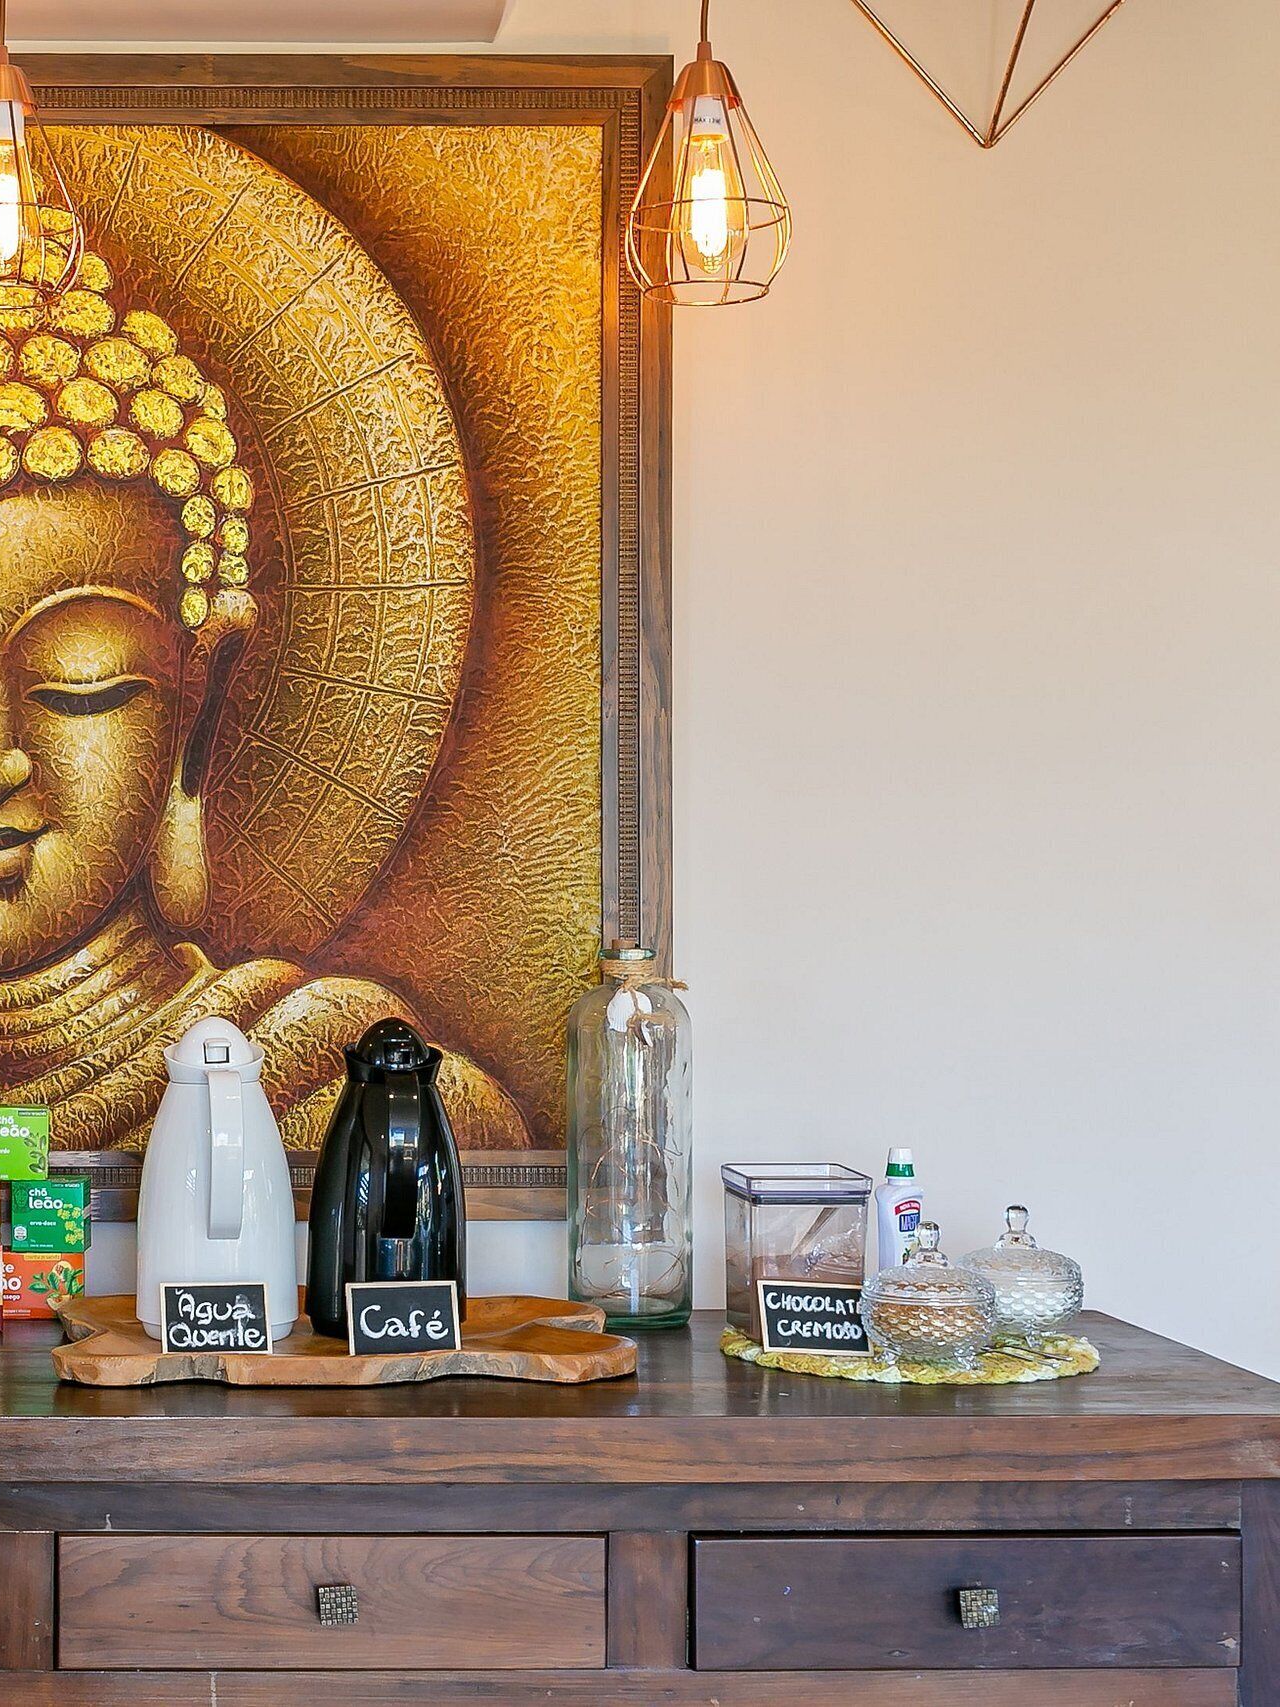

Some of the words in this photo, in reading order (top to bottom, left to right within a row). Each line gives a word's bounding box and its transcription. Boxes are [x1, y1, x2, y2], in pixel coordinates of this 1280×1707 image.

[29, 1197, 63, 1209] leão
[169, 1320, 266, 1348] Quente
[360, 1304, 449, 1340] Café
[777, 1319, 863, 1340] CREMOSO
